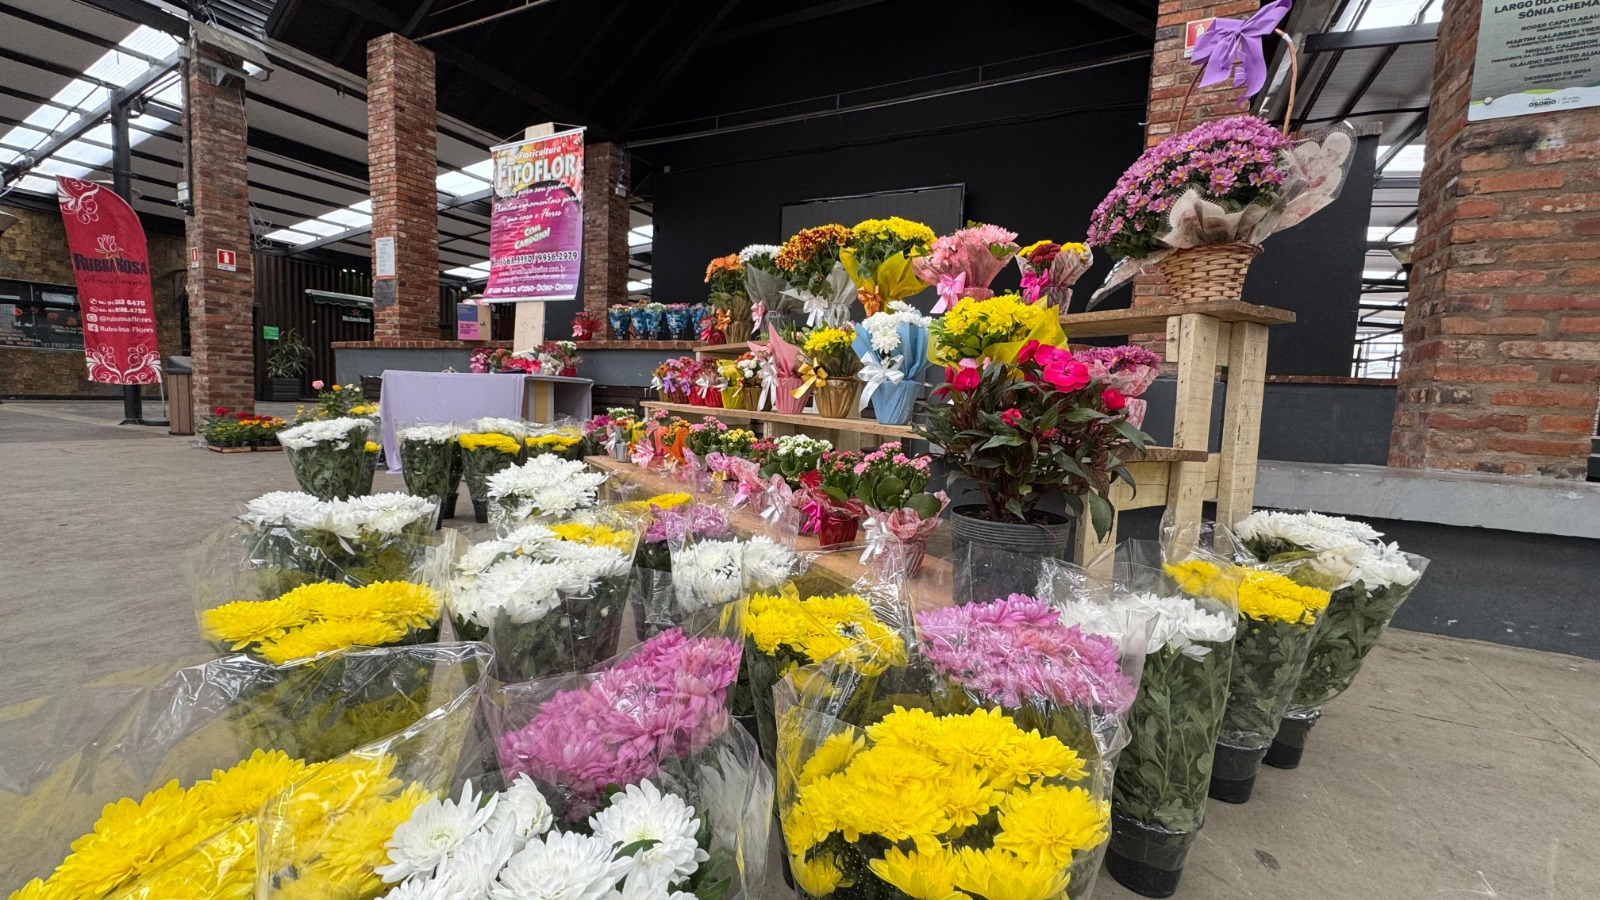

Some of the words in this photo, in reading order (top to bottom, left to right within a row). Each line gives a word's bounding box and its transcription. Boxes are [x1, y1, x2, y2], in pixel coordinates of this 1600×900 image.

[1494, 1, 1532, 13] LARGO
[1518, 7, 1554, 19] SÔNIA
[1557, 0, 1600, 12] CHEMA
[1521, 23, 1547, 31] ROGER
[1548, 18, 1576, 27] CAPUTI
[1506, 36, 1536, 45] MARTIM
[1537, 29, 1580, 40] CALABRESI
[1525, 45, 1553, 54] MIGUEL
[1556, 38, 1598, 49] CALDERON
[1509, 59, 1542, 68] CLÁUDIO
[1544, 53, 1579, 63] ROBERTO
[1524, 72, 1562, 81] DEZEMBRO
[519, 146, 562, 159] Floricultura
[524, 224, 541, 237] COM
